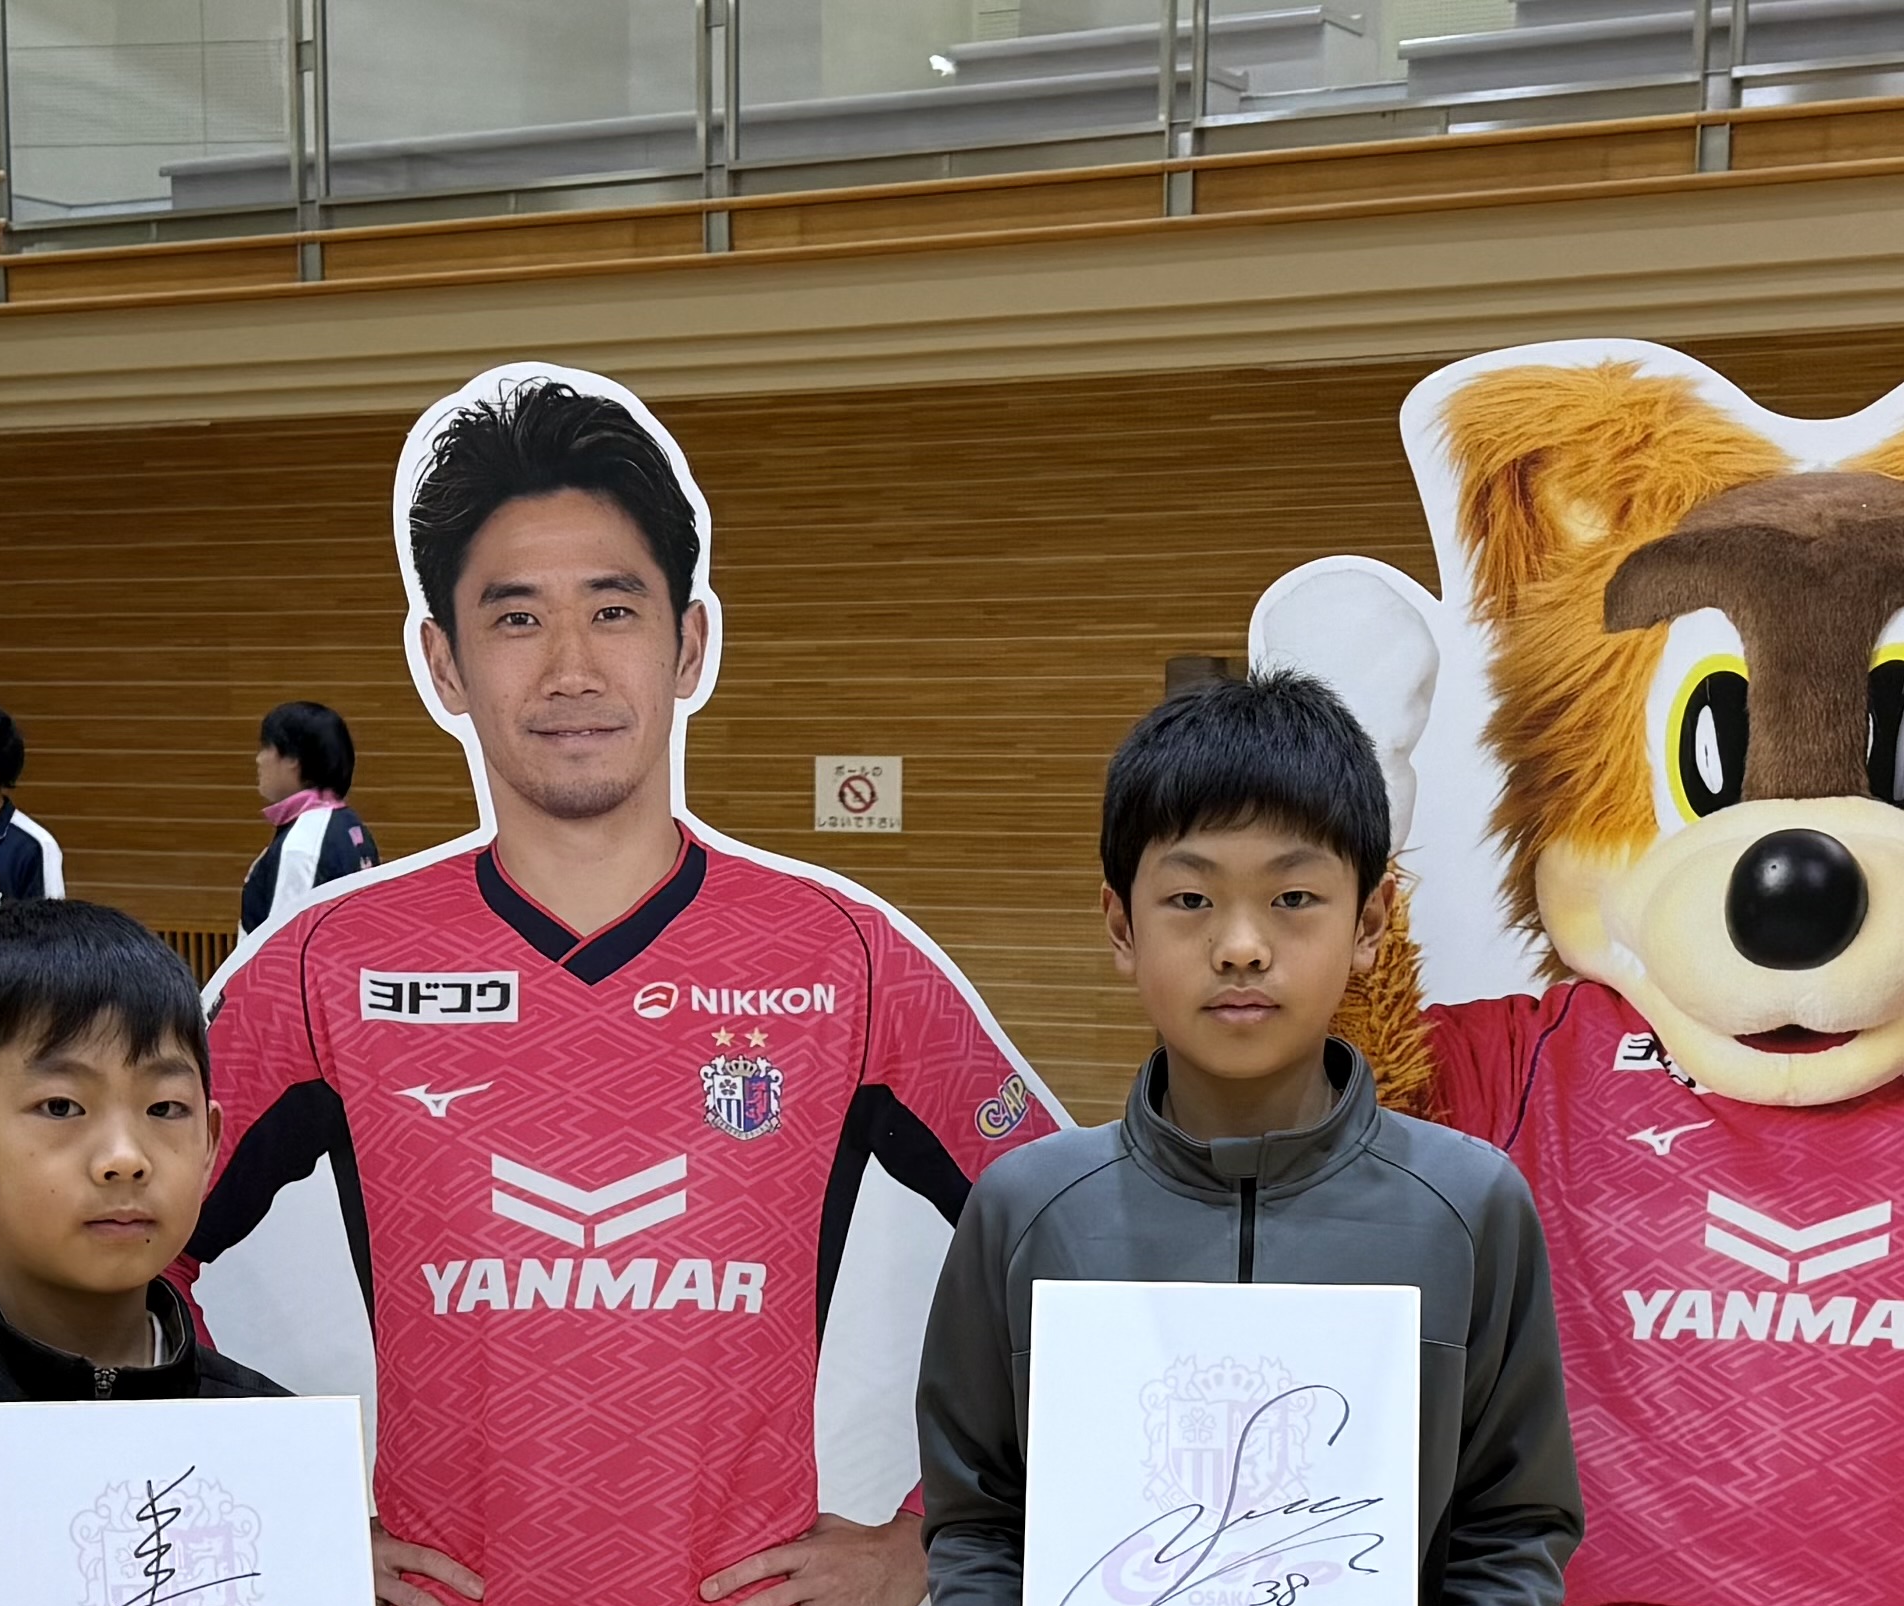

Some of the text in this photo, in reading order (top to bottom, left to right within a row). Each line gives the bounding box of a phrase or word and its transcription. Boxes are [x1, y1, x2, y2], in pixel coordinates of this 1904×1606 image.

[368, 980, 512, 1016] ヨドコウ
[691, 983, 836, 1016] NIKKON
[421, 1258, 767, 1315] YANMAR
